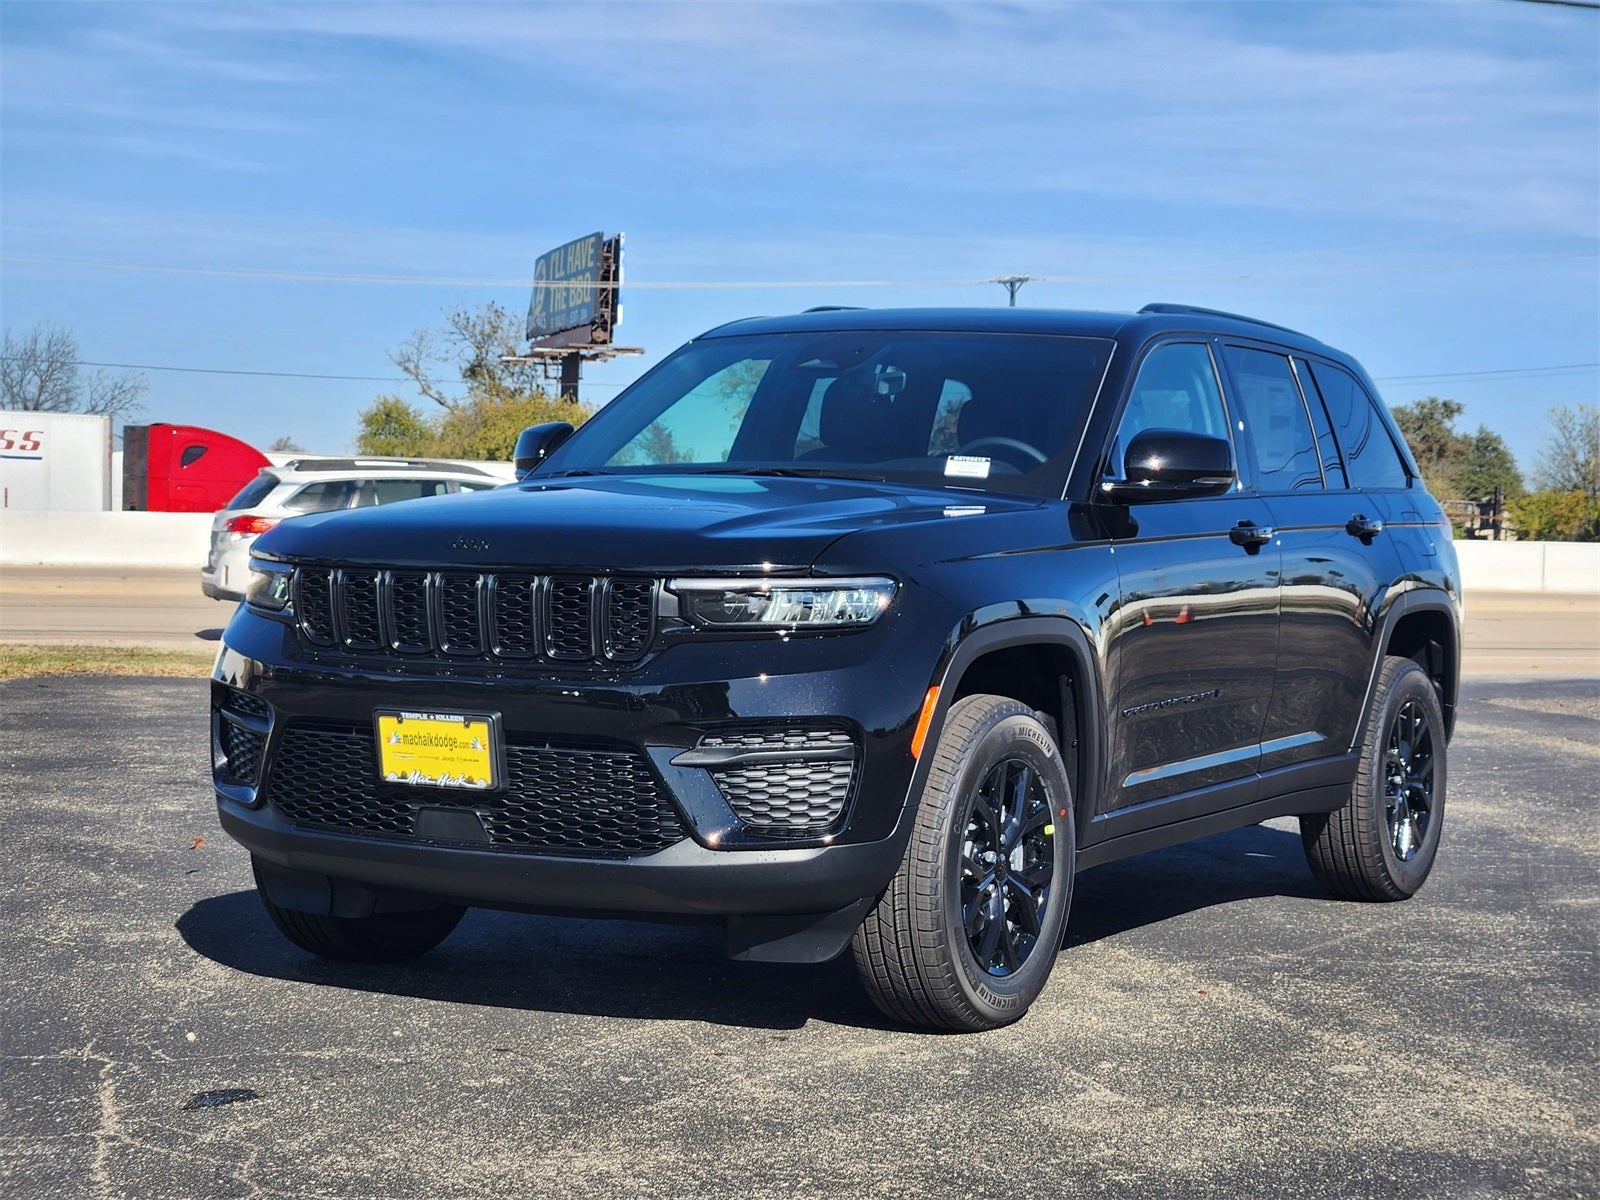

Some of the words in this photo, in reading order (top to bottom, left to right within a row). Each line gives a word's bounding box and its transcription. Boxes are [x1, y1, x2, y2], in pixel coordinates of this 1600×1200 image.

[550, 248, 565, 280] I'LL
[567, 237, 595, 273] HAVE
[549, 281, 567, 313] THE
[569, 272, 591, 307] BBQ
[400, 711, 428, 720] TEMPLE
[435, 714, 465, 722] KILLEEN
[402, 731, 470, 751] machaikdodge.com
[1018, 727, 1051, 753] MICHELIN
[979, 986, 1018, 1008] MICHELIN
